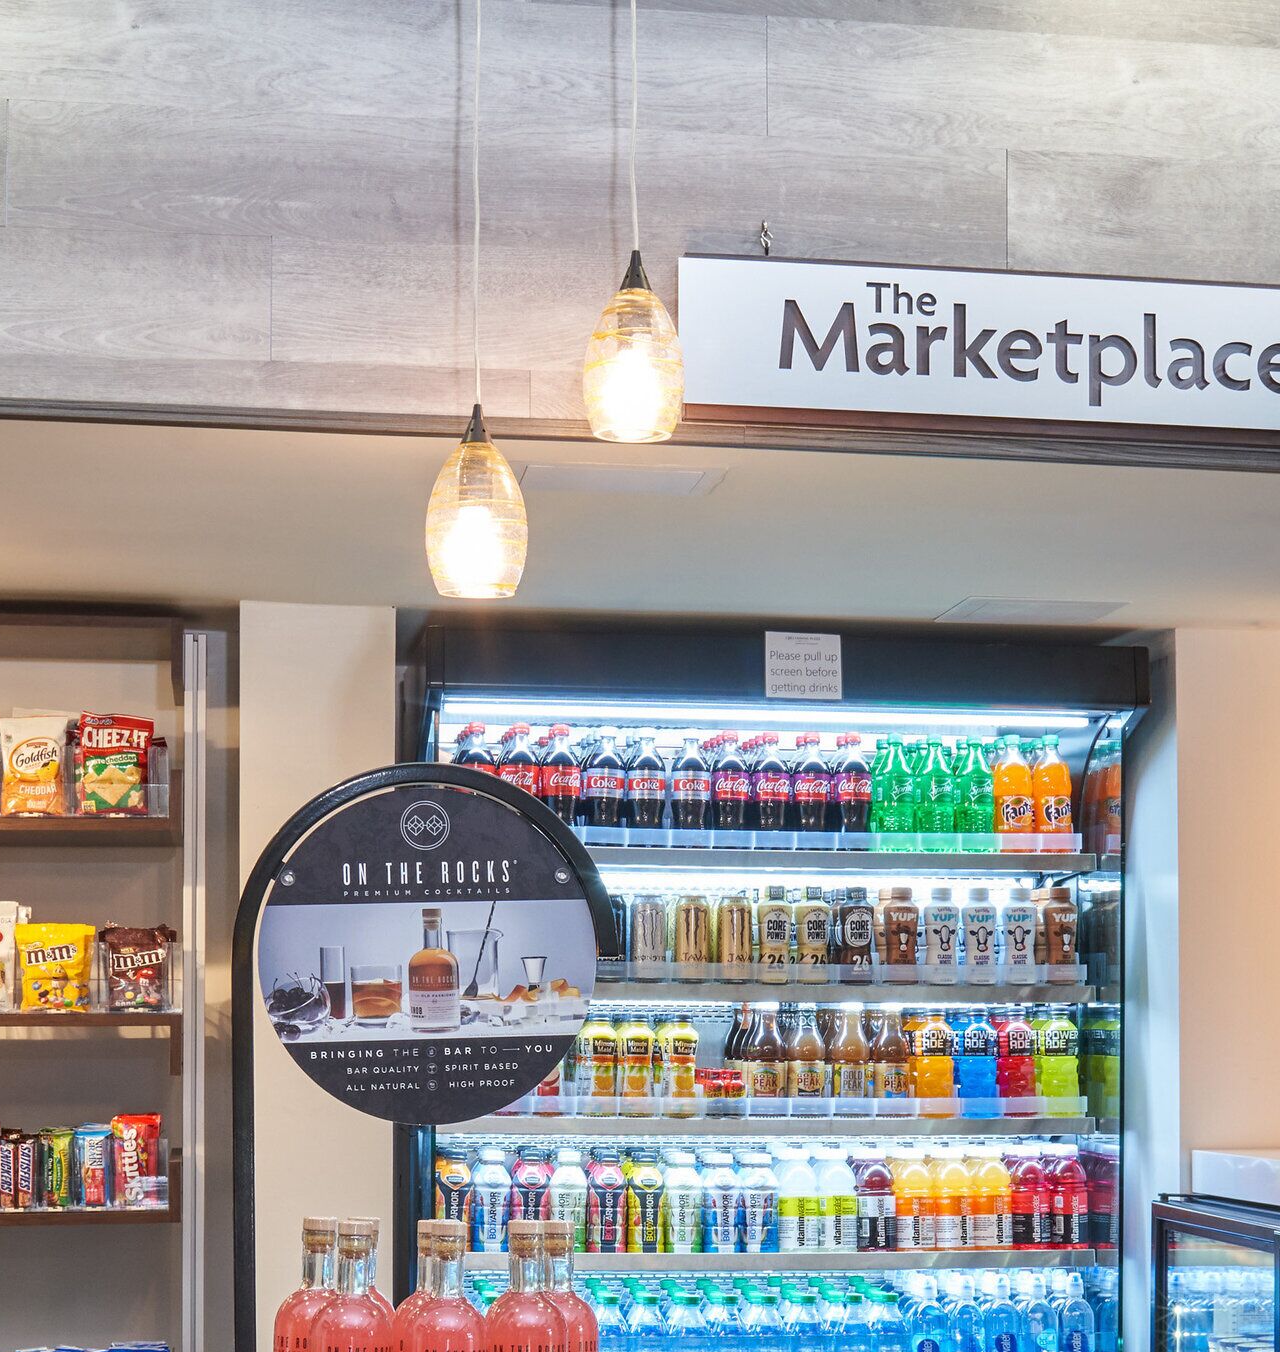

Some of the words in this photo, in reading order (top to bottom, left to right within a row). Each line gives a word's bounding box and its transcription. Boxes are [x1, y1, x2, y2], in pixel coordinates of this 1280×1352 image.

[866, 282, 936, 316] The
[770, 651, 800, 660] Please
[804, 652, 821, 663] pull
[825, 654, 838, 663] up
[771, 668, 802, 676] screen
[806, 667, 837, 677] before
[771, 683, 805, 694] getting
[809, 683, 838, 693] drinks
[15, 747, 58, 768] Goldfish
[591, 776, 617, 789] Coke
[633, 779, 659, 790] Coke
[679, 779, 705, 790] Coke
[19, 783, 57, 795] CHEDDAR
[342, 863, 368, 886] ON
[385, 861, 423, 885] THE
[343, 889, 413, 897] PREMIUM
[424, 887, 511, 896] COCKTAILS
[890, 912, 917, 922] YUP!
[969, 913, 995, 923] YUP!
[1006, 913, 1032, 923] YUP!
[850, 920, 869, 931] CORE
[850, 930, 869, 940] POWER
[310, 1049, 384, 1060] BRINGING
[393, 1048, 420, 1057] THE
[444, 1046, 472, 1056] BAR
[481, 1045, 498, 1055] TO
[525, 1043, 554, 1054] YOU
[346, 1066, 369, 1075] BAR
[373, 1065, 420, 1075] QUALITY
[445, 1063, 479, 1072] SPIRIT
[484, 1062, 518, 1071] BASED
[346, 1083, 366, 1092] ALL
[371, 1081, 420, 1091] NATURAL
[449, 1080, 475, 1089] HIGH
[479, 1079, 516, 1088] PROOF
[843, 1078, 863, 1090] PEAK
[0, 1146, 13, 1193] SNICKERS
[19, 1143, 32, 1193] SATISFIES
[123, 1128, 144, 1200] Skittles
